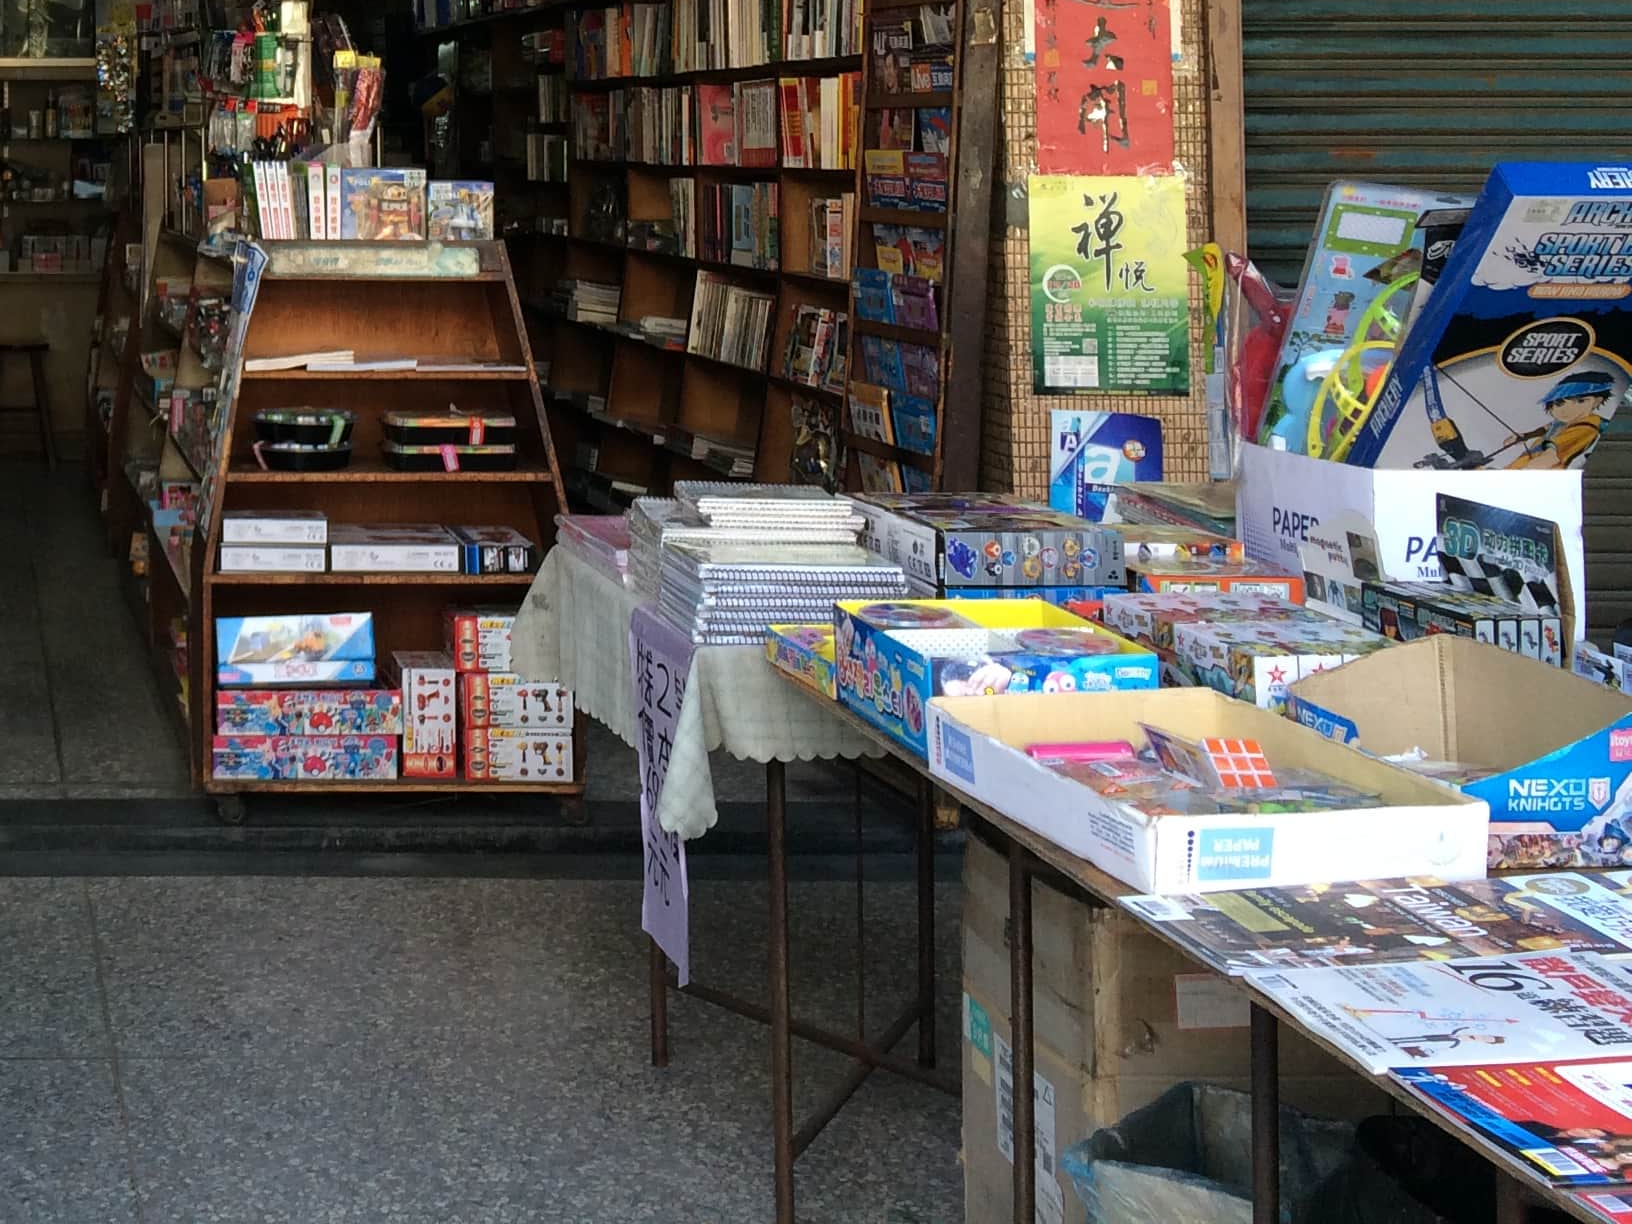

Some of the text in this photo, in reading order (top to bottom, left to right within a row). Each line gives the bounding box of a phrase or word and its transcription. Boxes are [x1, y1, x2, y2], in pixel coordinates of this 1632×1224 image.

[1543, 255, 1632, 279] SERIES
[1522, 332, 1582, 349] SPORT
[1506, 347, 1579, 366] SERIES
[1444, 516, 1481, 561] 3D
[1296, 705, 1336, 738] NEXO
[1508, 777, 1586, 796] NEXO
[1507, 797, 1585, 812] KNIHGTS
[1213, 838, 1260, 853] PAPER
[1200, 855, 1270, 868] PREMIUM
[1381, 883, 1489, 938] Taiwan
